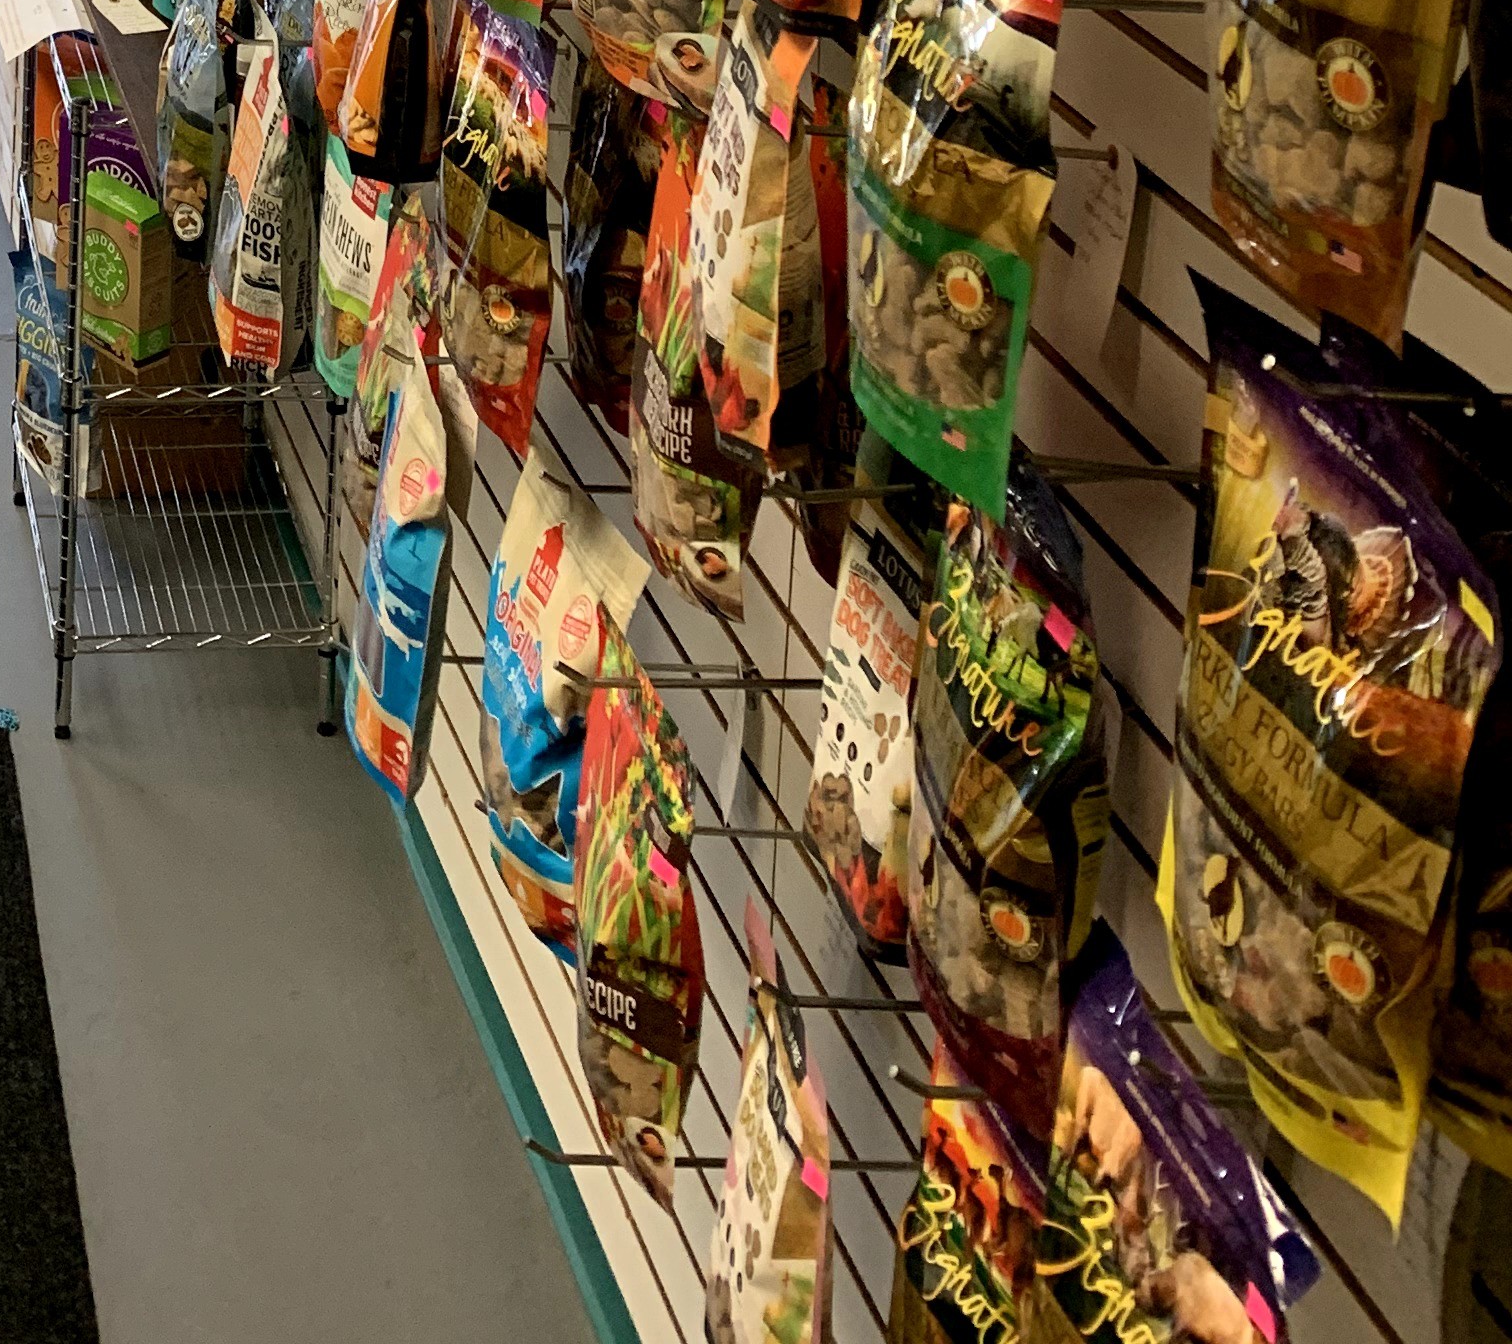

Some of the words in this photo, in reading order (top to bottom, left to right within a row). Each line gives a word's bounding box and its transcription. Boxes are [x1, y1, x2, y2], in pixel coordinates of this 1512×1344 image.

[87, 231, 123, 263] BUDDY
[336, 212, 373, 274] CHEWS
[236, 318, 279, 338] SUPPORTS
[878, 544, 922, 612] LOTUS
